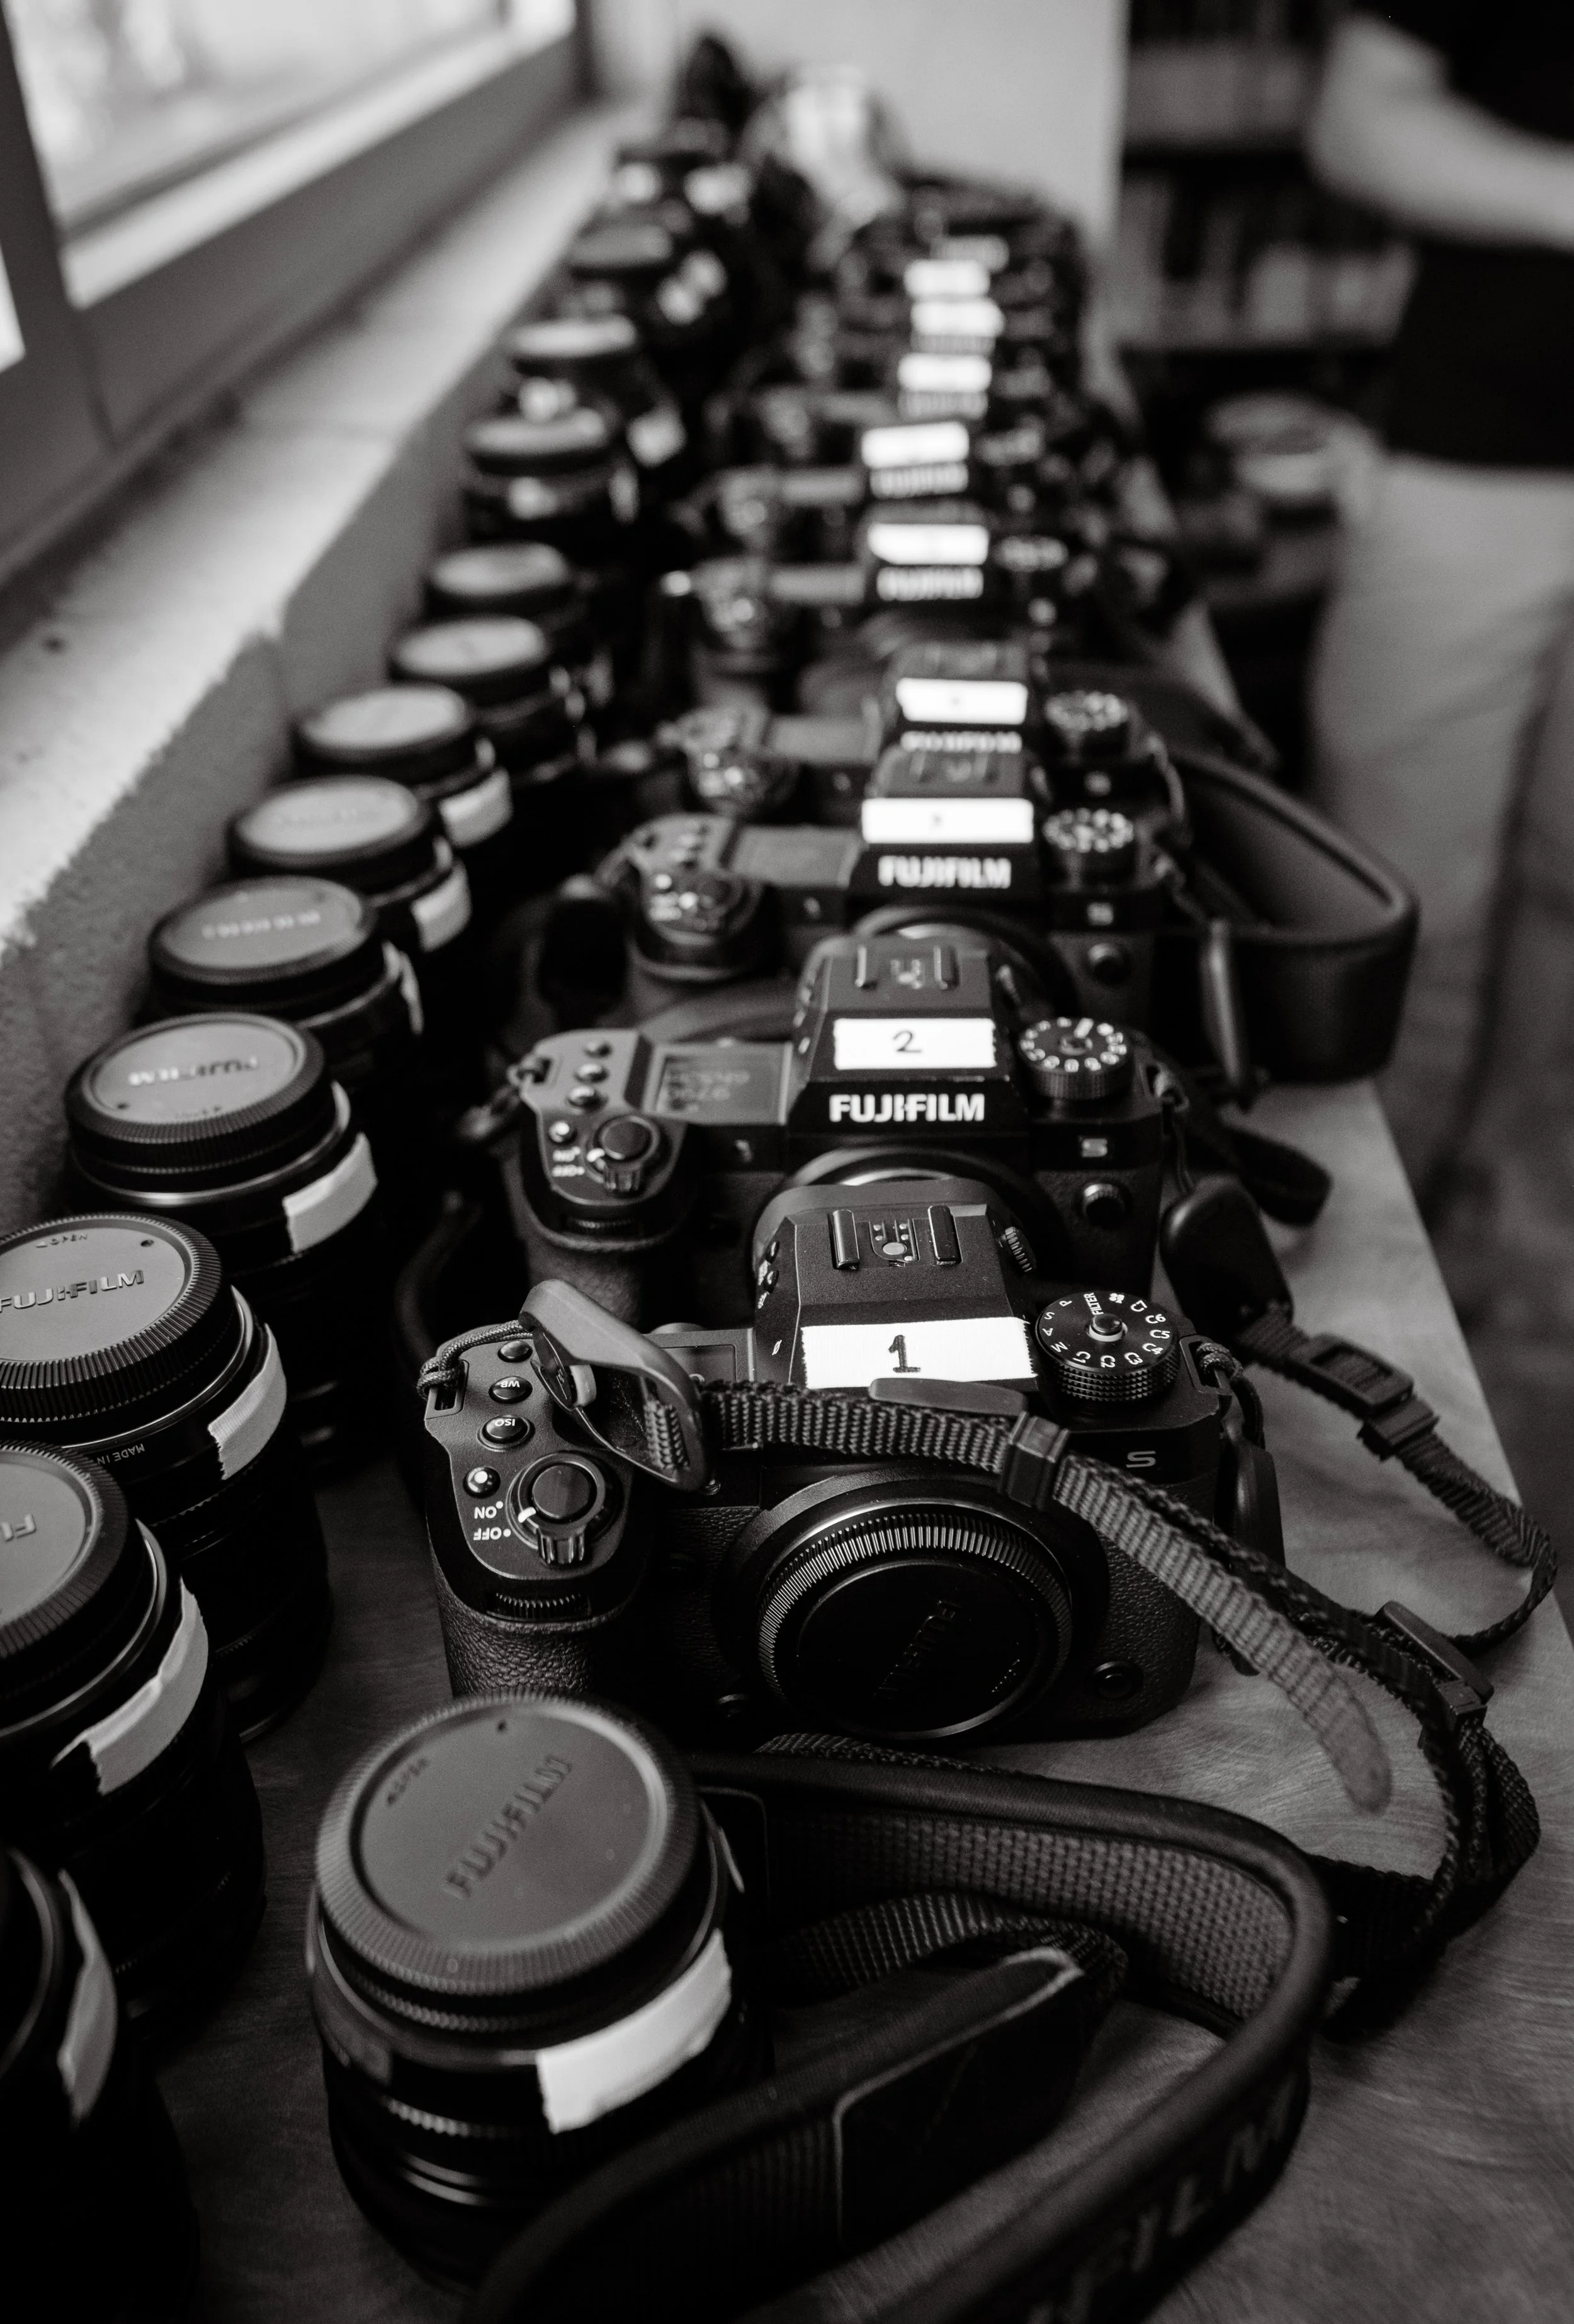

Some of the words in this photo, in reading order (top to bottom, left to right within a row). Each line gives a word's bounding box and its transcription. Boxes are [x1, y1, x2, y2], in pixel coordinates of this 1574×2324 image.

[892, 1030, 922, 1053] 2
[829, 1094, 985, 1123] FUJIFILM
[50, 1233, 88, 1246] OPEN
[0, 1269, 144, 1313] FUJIFILM
[1059, 1299, 1073, 1307] P
[1083, 1292, 1104, 1316] FILTER
[1130, 1300, 1148, 1312] C7
[1044, 1312, 1055, 1320] S
[1145, 1313, 1167, 1324] C6
[1042, 1327, 1054, 1337] A
[1149, 1329, 1171, 1339] C5
[1050, 1341, 1069, 1352] M
[1141, 1342, 1164, 1355] C4
[888, 1334, 920, 1373] 1
[1072, 1351, 1092, 1364] C1
[1124, 1352, 1143, 1365] C3
[1100, 1354, 1116, 1368] C2
[494, 1418, 516, 1427] ISO
[112, 1443, 145, 1461] MADE
[96, 1454, 111, 1465] IN
[1126, 1450, 1157, 1468] S
[473, 1505, 497, 1519] ON
[473, 1526, 502, 1541] OFF
[446, 1754, 572, 1899] FUJIFILM
